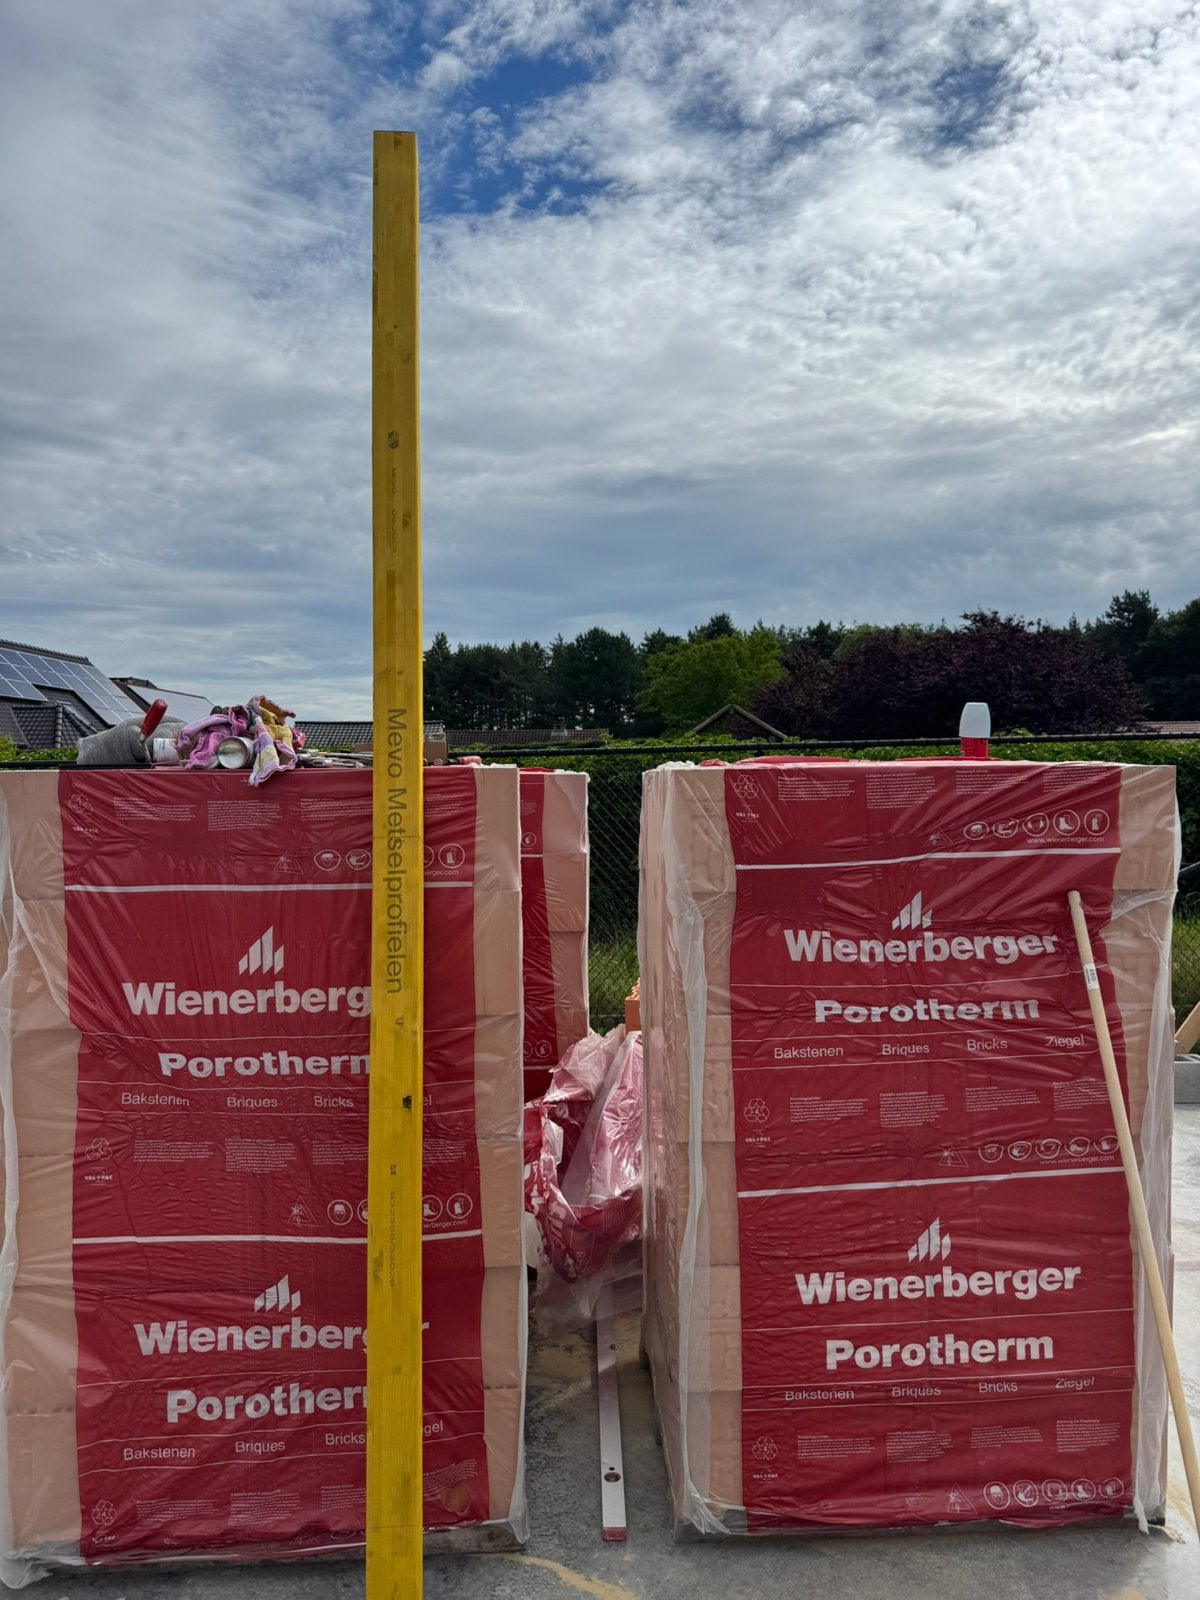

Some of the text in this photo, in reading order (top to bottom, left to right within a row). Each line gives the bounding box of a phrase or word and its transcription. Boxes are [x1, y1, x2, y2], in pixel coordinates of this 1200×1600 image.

[382, 708, 407, 994] Mevo Metselprofielen
[783, 928, 1059, 966] Wienerberger
[121, 981, 371, 1018] Wienerberg
[814, 997, 1040, 1024] Porotherm
[773, 1033, 1086, 1059] Bakstenen Briques Bricks Ziegel
[121, 1091, 354, 1110] Bakstenen Briques Bricks
[794, 1265, 1082, 1306] Wienerberger
[134, 1316, 429, 1357] Wienerber
[825, 1334, 1054, 1371] Porotherm
[166, 1382, 367, 1424] Porother
[785, 1387, 855, 1402] Bakstenen
[891, 1385, 942, 1399] Briques
[978, 1380, 1019, 1394] Bricks
[123, 1445, 196, 1461] Bakstenen
[235, 1438, 286, 1454] Briques
[325, 1433, 366, 1446] Bricks
